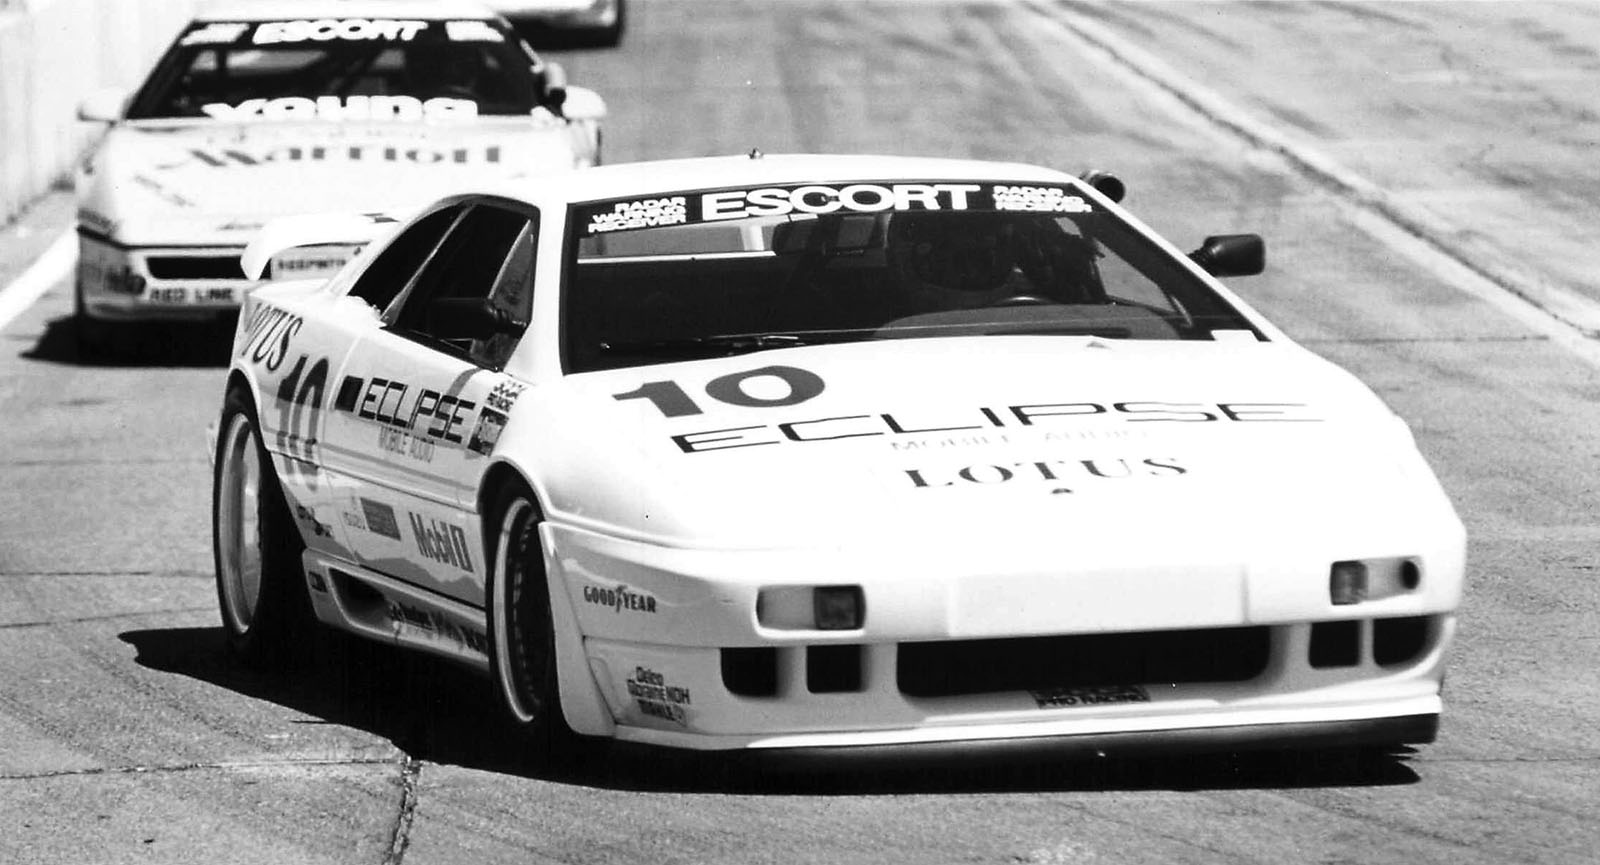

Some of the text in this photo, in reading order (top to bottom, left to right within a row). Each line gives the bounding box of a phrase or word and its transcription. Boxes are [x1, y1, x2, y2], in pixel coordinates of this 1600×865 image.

[252, 18, 428, 45] ESCORT
[615, 196, 687, 213] RADAR
[702, 184, 981, 222] ESCORT
[993, 185, 1064, 197] RADAR
[588, 214, 687, 233] RECEIVER
[592, 206, 687, 223] WARNING
[612, 364, 827, 418] 10
[275, 354, 329, 492] 10
[359, 377, 476, 443] ECLIPSE
[670, 401, 1325, 454] ECLIPSE
[904, 458, 1190, 488] LOTUS
[409, 511, 458, 567] Mobil
